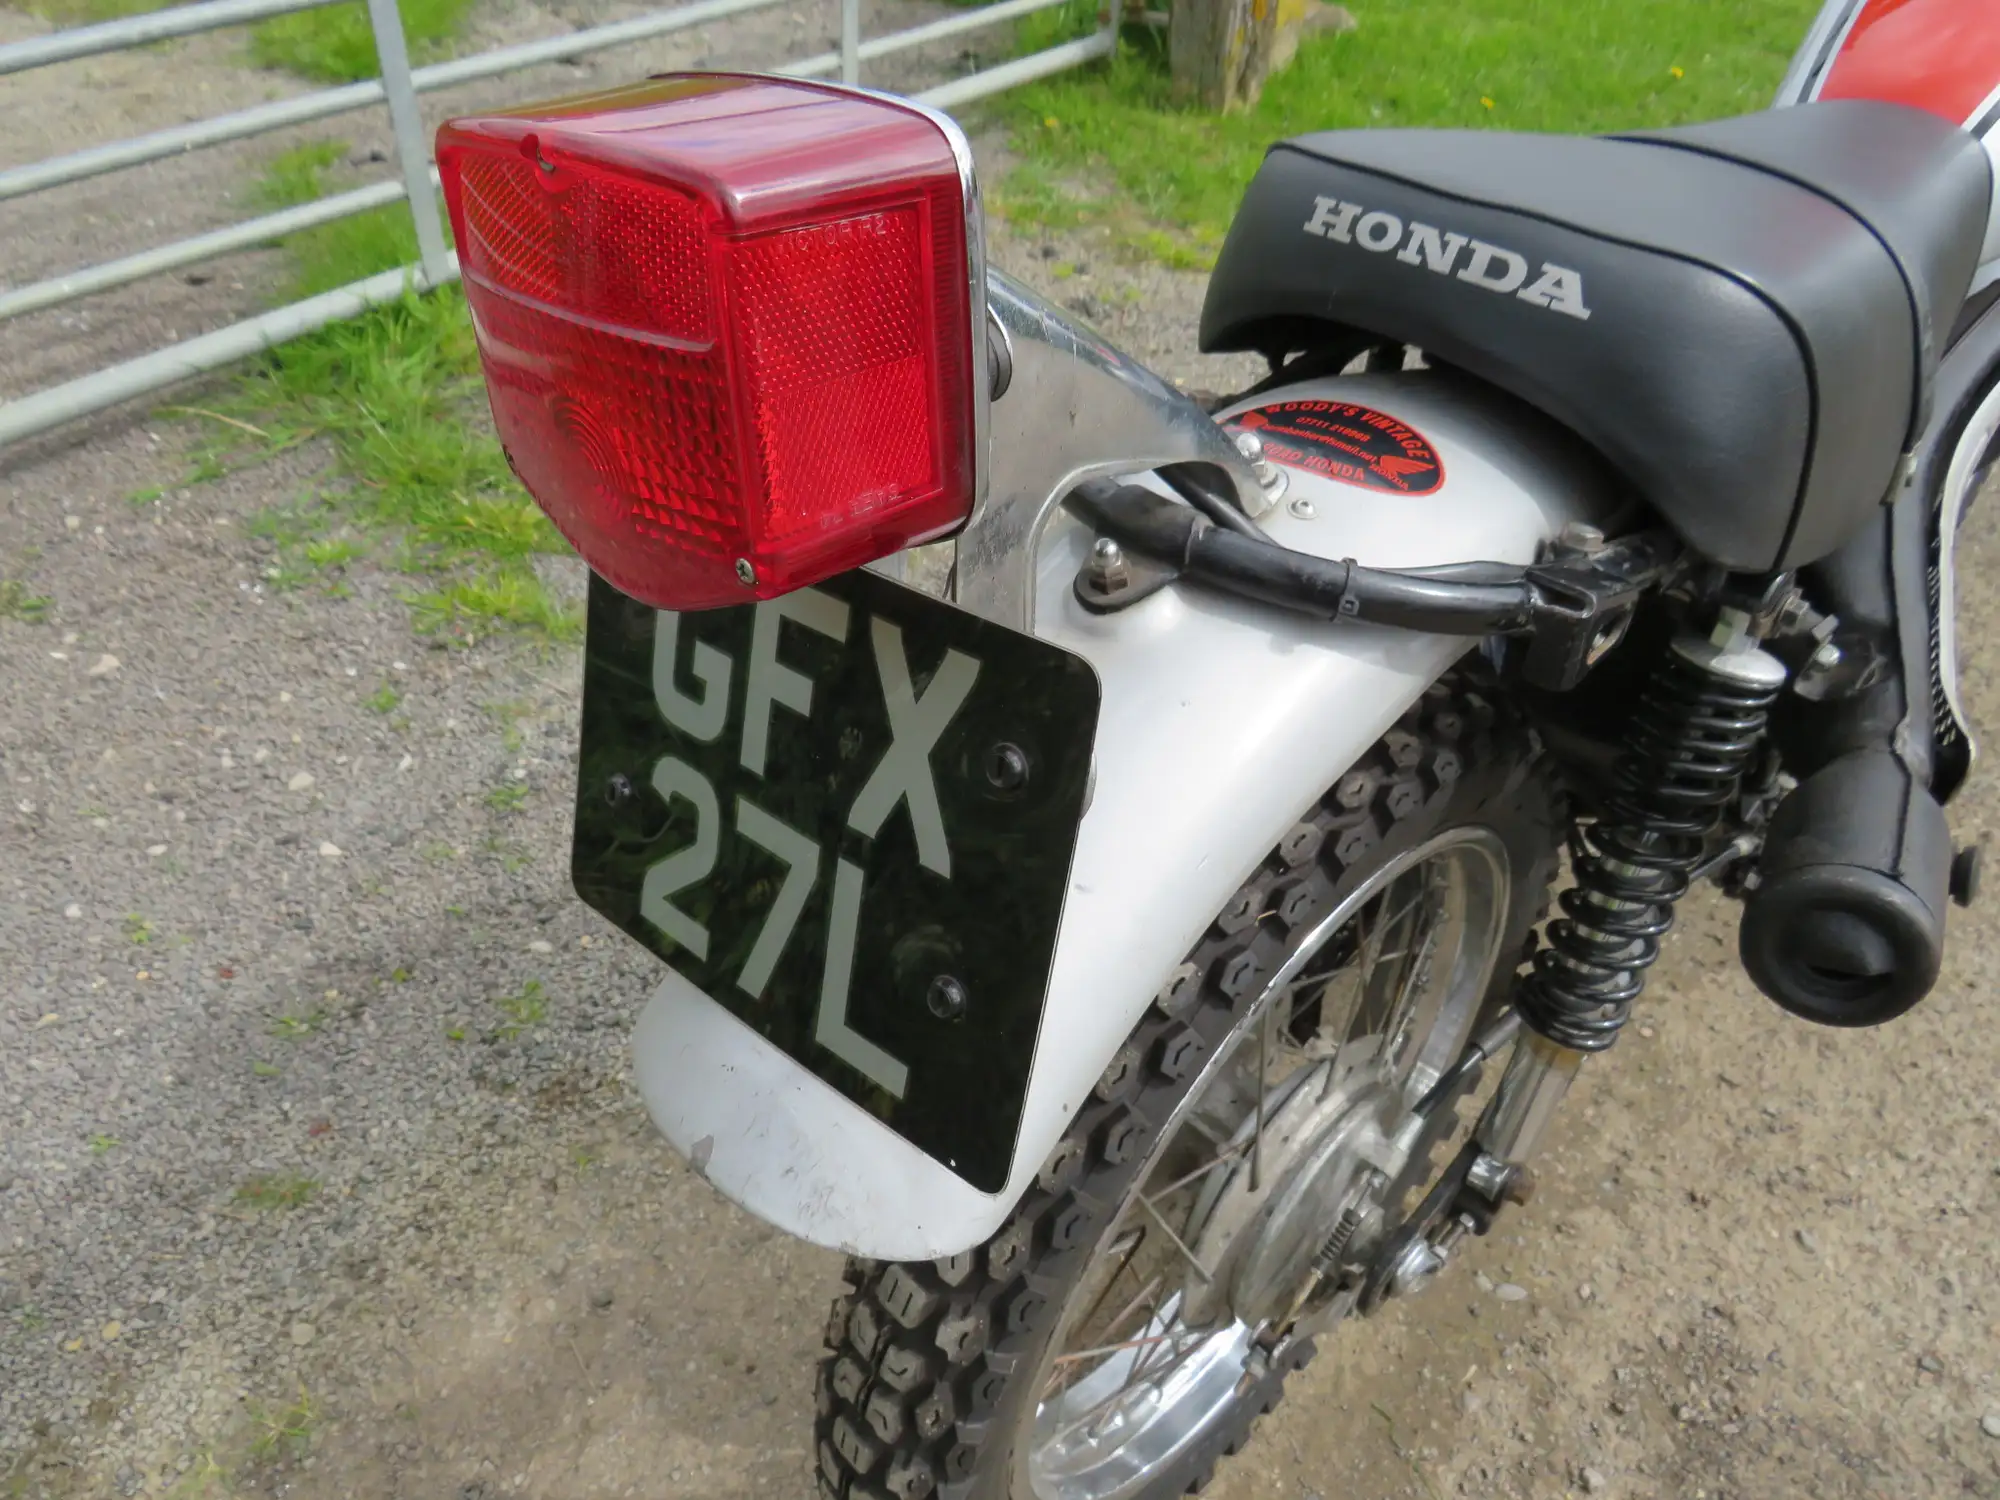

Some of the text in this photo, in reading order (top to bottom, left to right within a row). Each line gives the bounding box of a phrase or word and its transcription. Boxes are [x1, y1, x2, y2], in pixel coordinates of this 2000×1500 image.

[1303, 193, 1592, 321] HONDA
[1265, 401, 1430, 460] WOODY'S VINTAGE
[1304, 455, 1364, 480] HONDA
[652, 585, 984, 880] GFX
[640, 755, 911, 1100] 27L
